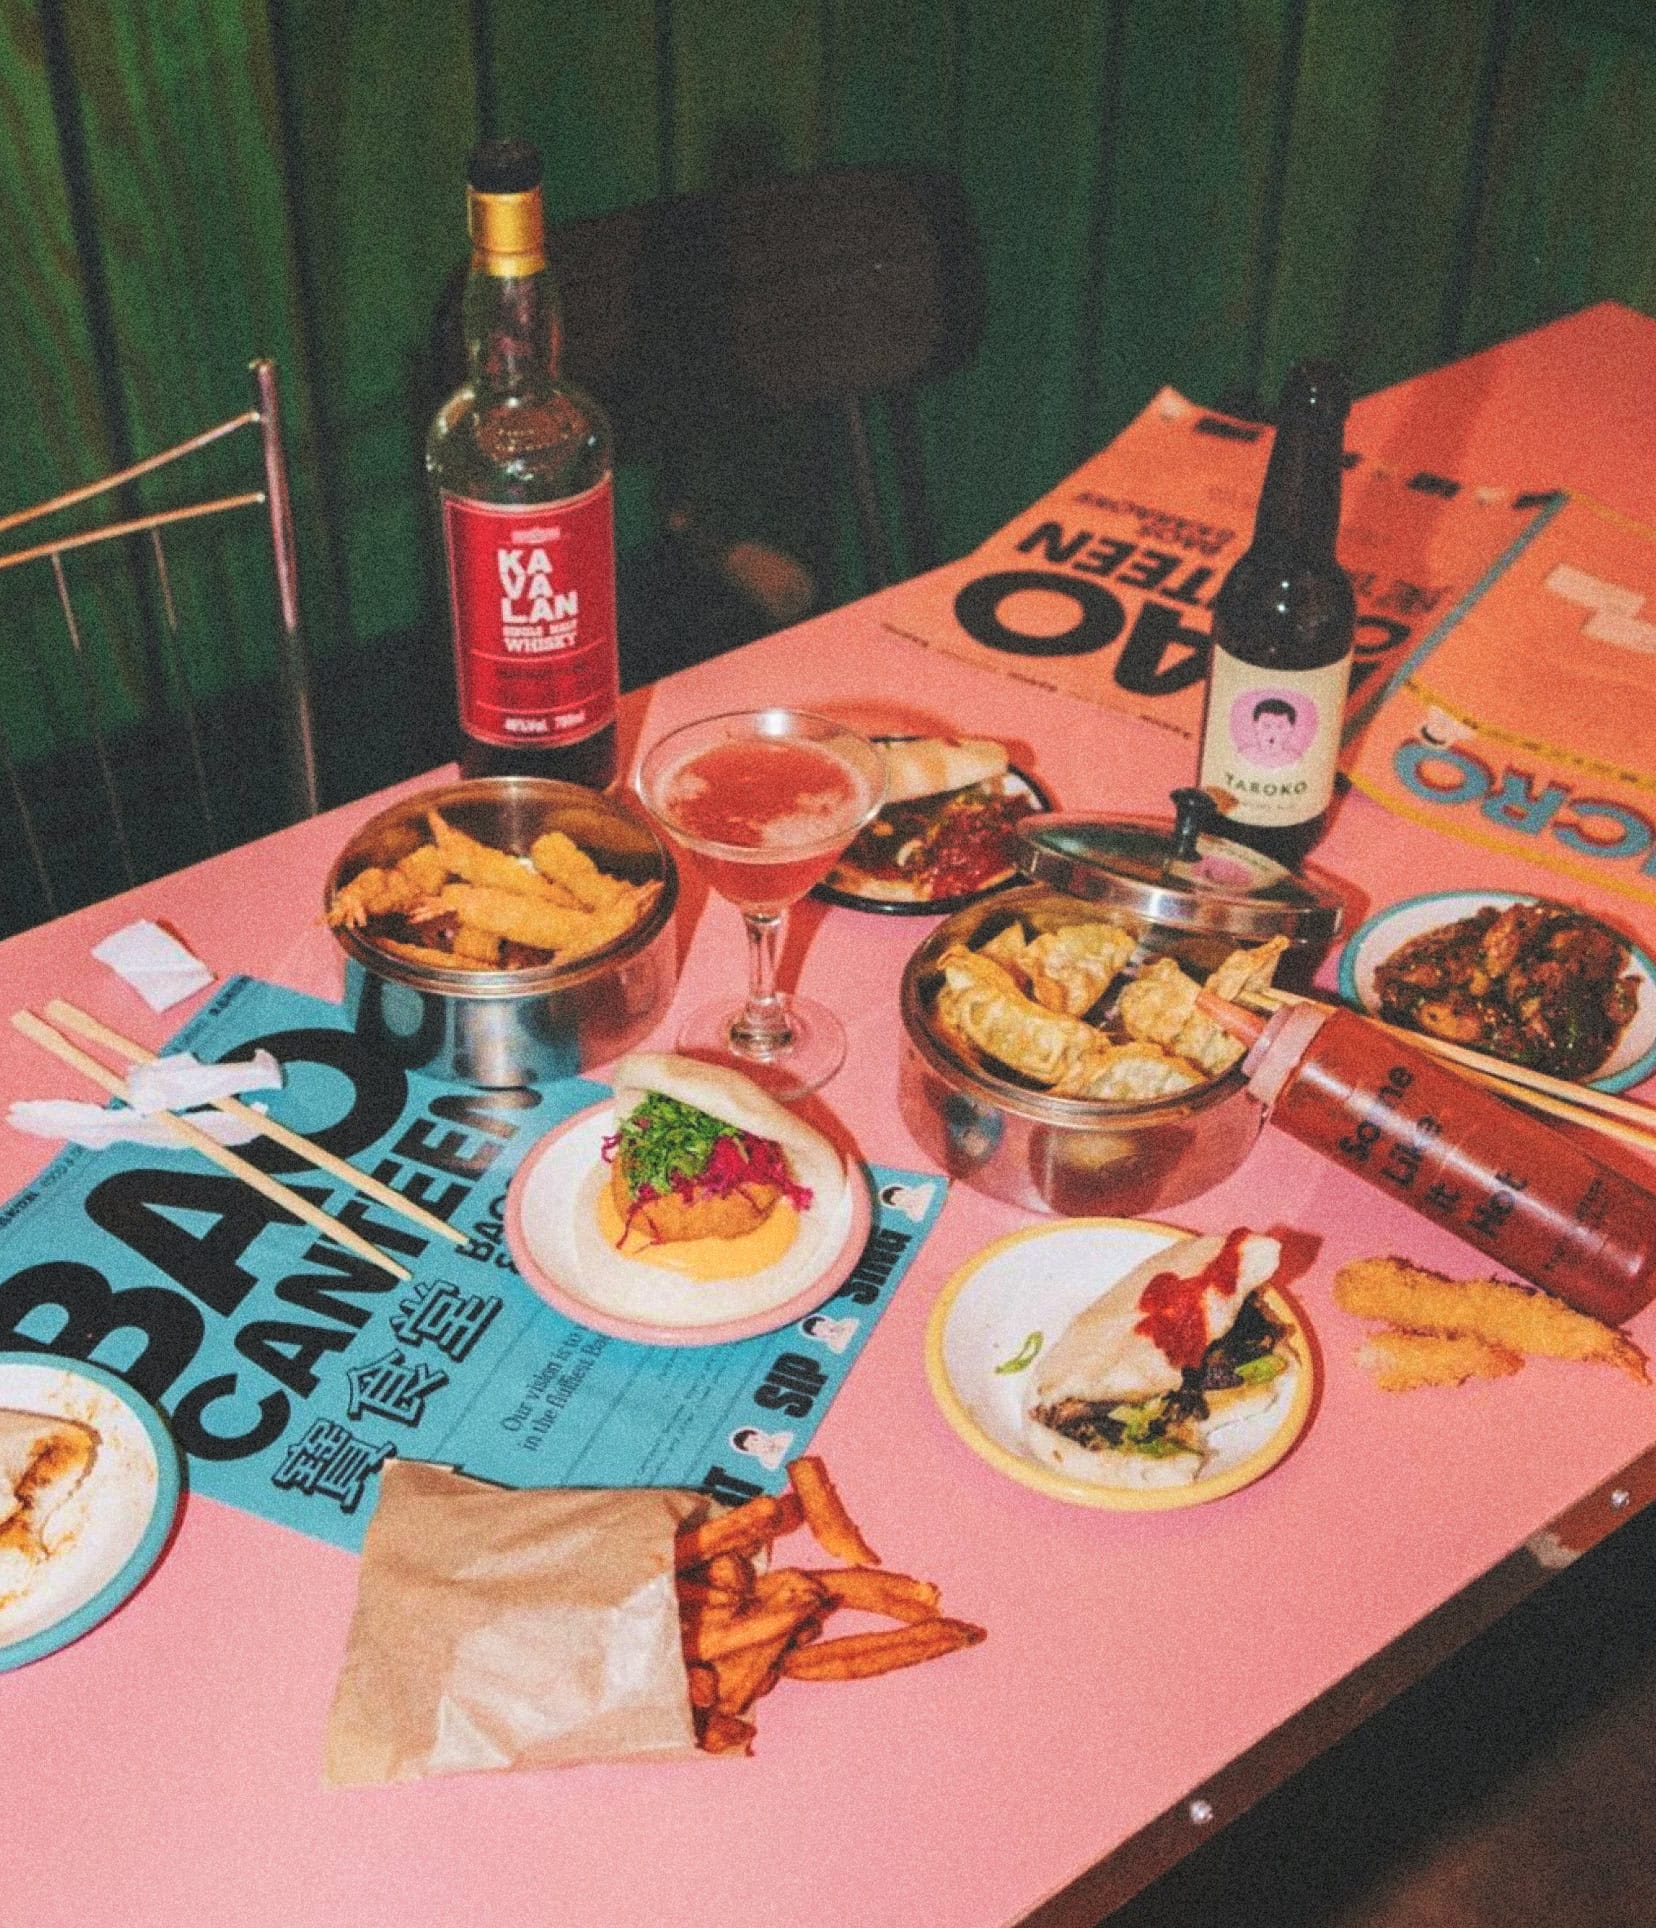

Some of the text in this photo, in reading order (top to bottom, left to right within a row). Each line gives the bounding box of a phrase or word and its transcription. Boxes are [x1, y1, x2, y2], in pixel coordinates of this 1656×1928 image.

[1225, 772, 1307, 796] TAROKO
[1392, 738, 1656, 878] CRO
[1424, 1183, 1461, 1212] It
[1466, 1168, 1529, 1239] Hot
[173, 1087, 544, 1462] CANTEEN
[501, 1332, 583, 1432] Our vision is to
[753, 1352, 829, 1419] SIP
[519, 1434, 543, 1452] in
[534, 1409, 558, 1434] the
